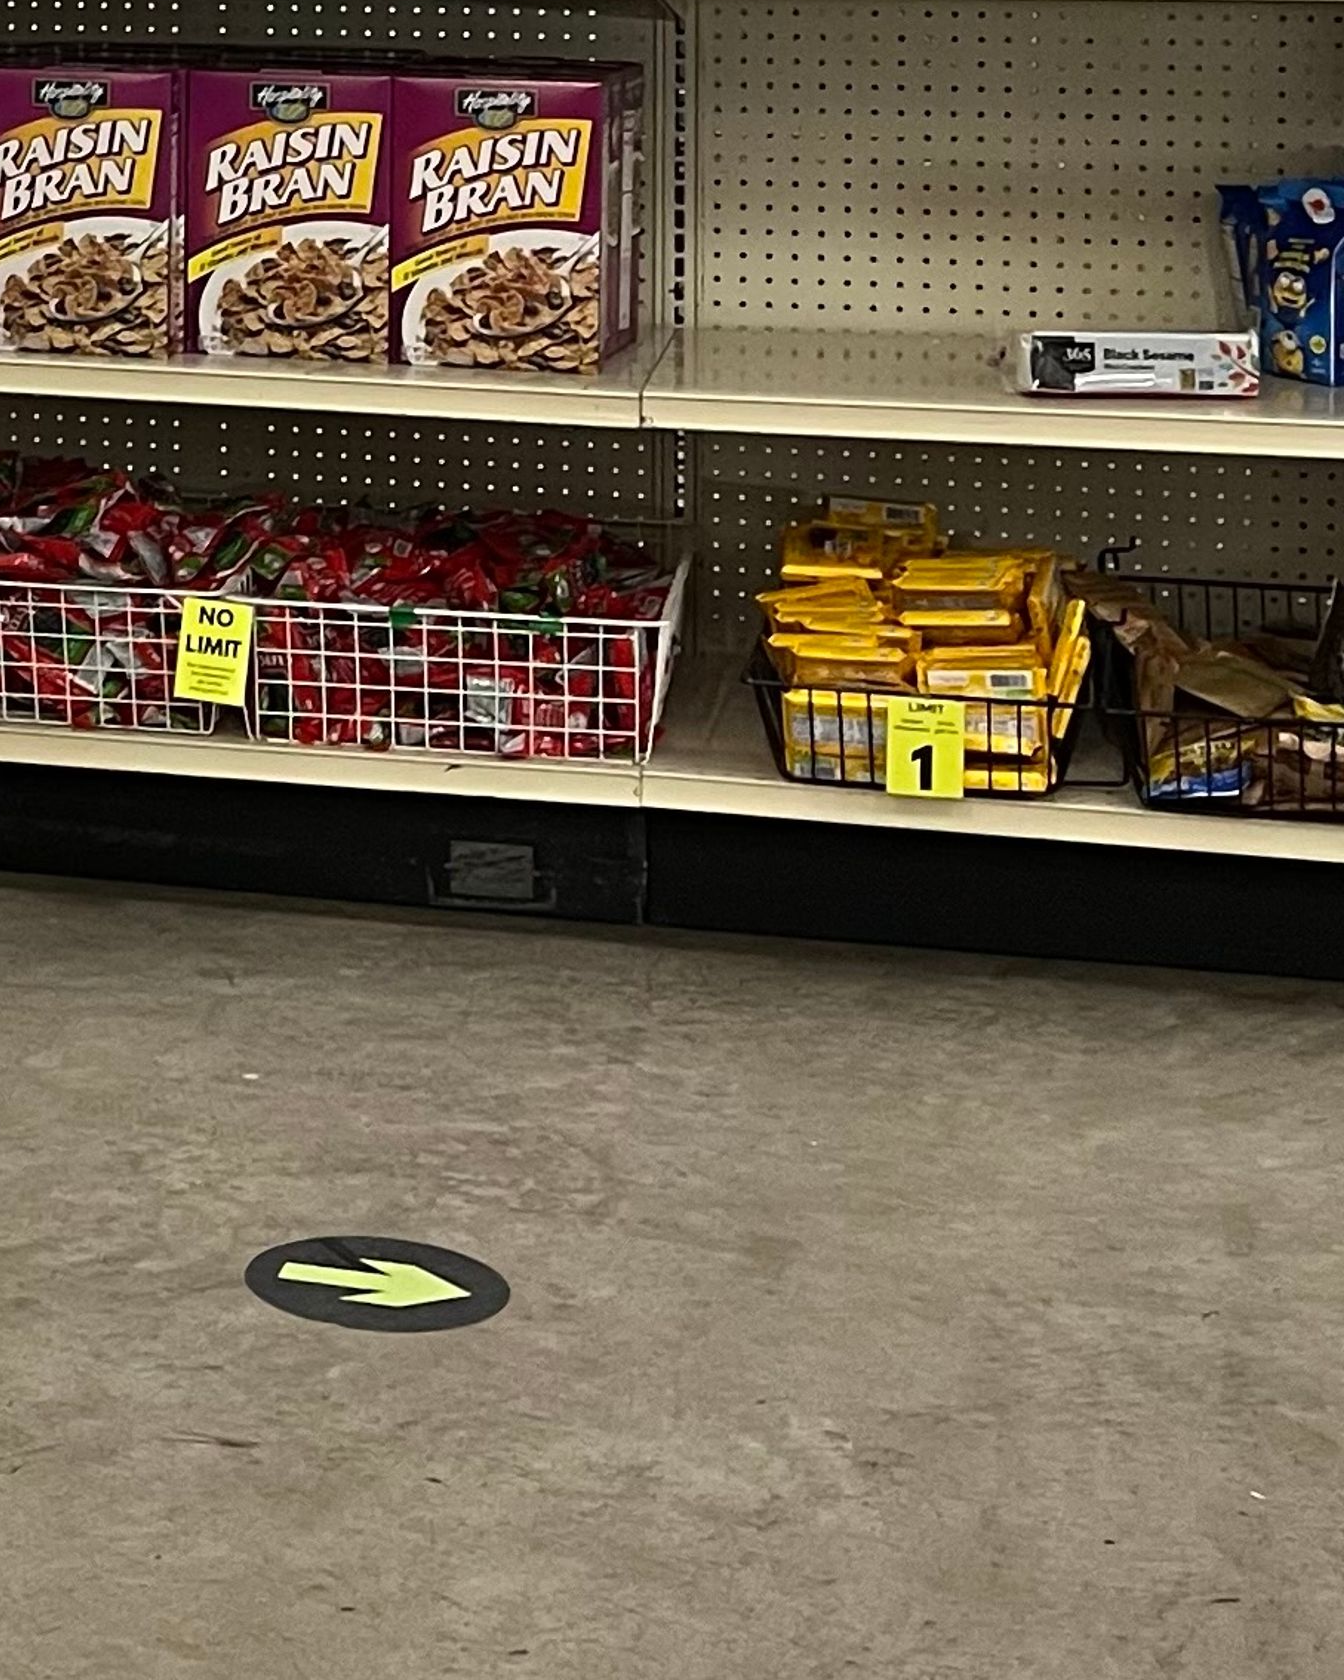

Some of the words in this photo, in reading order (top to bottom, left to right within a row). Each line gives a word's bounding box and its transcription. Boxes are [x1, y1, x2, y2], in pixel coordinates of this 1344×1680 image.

[205, 122, 370, 192] RAISIN
[409, 129, 578, 201] RAISIN
[1, 159, 133, 221] BRAN
[217, 163, 353, 226] BRAN
[421, 169, 565, 234] BRAN
[1062, 347, 1092, 362] 365
[1103, 348, 1140, 360] Black
[1142, 349, 1195, 361] Sesame
[199, 608, 234, 628] NO
[185, 634, 242, 660] LIMIT
[908, 702, 944, 715] LIMIT
[910, 744, 934, 792] 1
